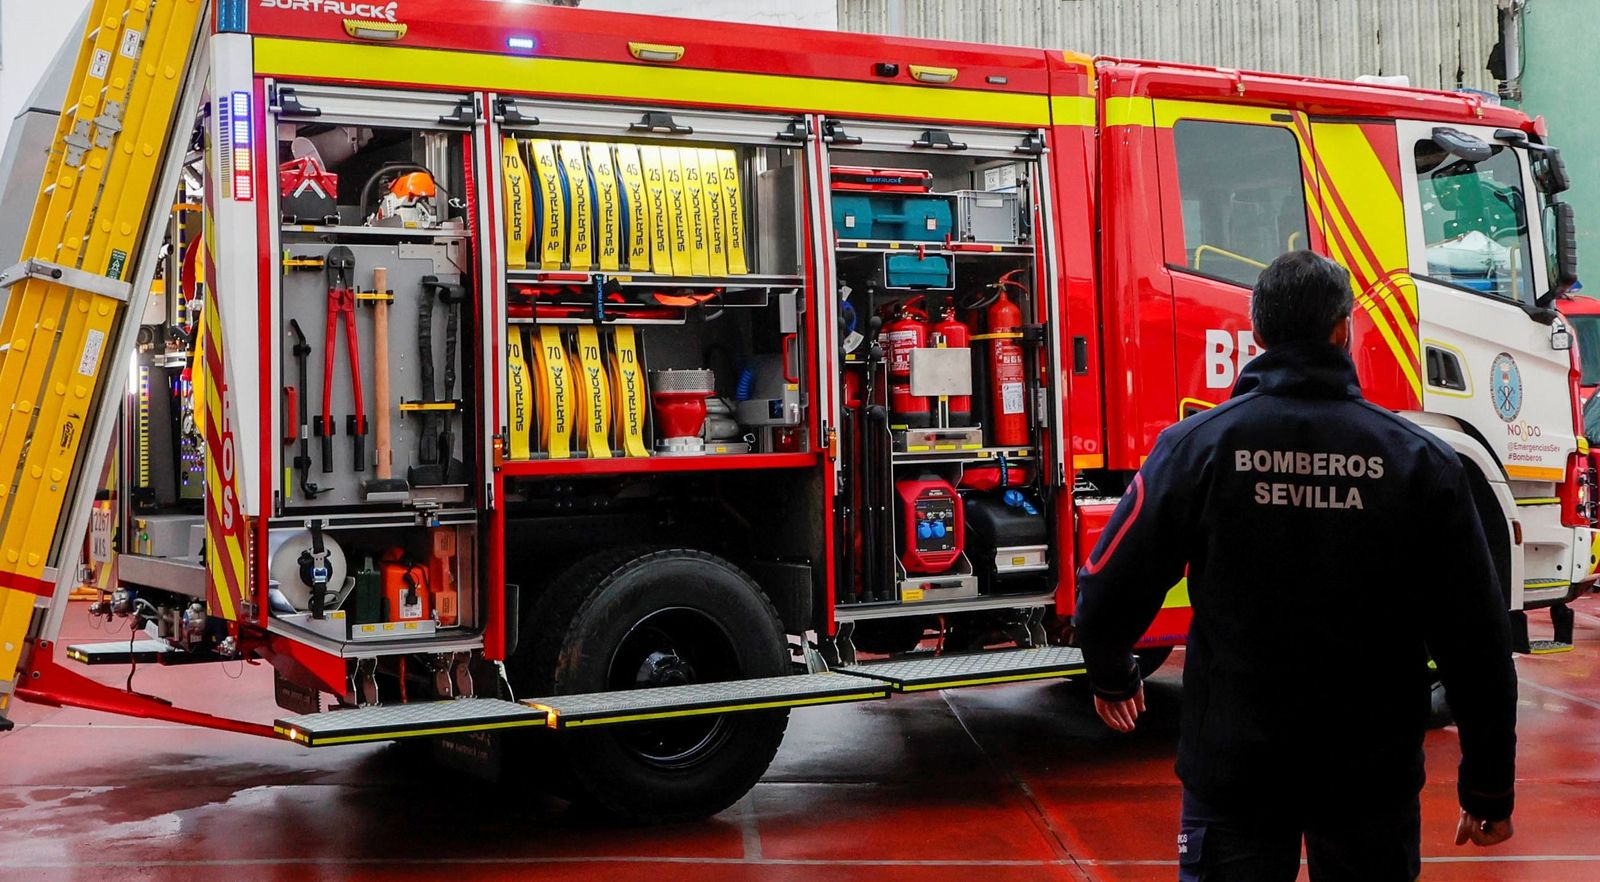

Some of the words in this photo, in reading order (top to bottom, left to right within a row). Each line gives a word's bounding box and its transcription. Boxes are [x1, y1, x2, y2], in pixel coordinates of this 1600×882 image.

[504, 155, 519, 169] 70
[540, 155, 553, 167] 45
[569, 158, 582, 171] 45
[598, 163, 610, 176] 45
[626, 163, 639, 176] 45
[648, 168, 661, 182] 25
[667, 169, 680, 183] 25
[686, 167, 698, 181] 25
[723, 167, 735, 180] 25
[706, 171, 718, 185] 25
[510, 174, 522, 241] SURTRUCK
[544, 174, 559, 238] SURTRUCK
[574, 177, 586, 242] SURTRUCK
[602, 182, 613, 247] SURTRUCK
[631, 182, 644, 246] SURTRUCK
[652, 188, 665, 252] SURTRUCK
[671, 189, 685, 253] SURTRUCK
[689, 187, 703, 250] SURTRUCK
[727, 186, 739, 249] SURTRUCK
[709, 191, 721, 254] SURTRUCK
[547, 241, 560, 251] AP
[575, 243, 587, 253] AP
[603, 247, 615, 257] AP
[632, 247, 644, 257] AP
[547, 346, 561, 360] 70
[584, 346, 598, 361] 70
[621, 349, 634, 364] 70
[511, 364, 524, 432] SURTRUCK
[551, 366, 565, 433] SURTRUCK
[588, 367, 602, 433] SURTRUCK
[624, 370, 638, 436] SURTRUCK
[1235, 450, 1385, 479] BOMBEROS
[1254, 482, 1364, 510] SEVILLA
